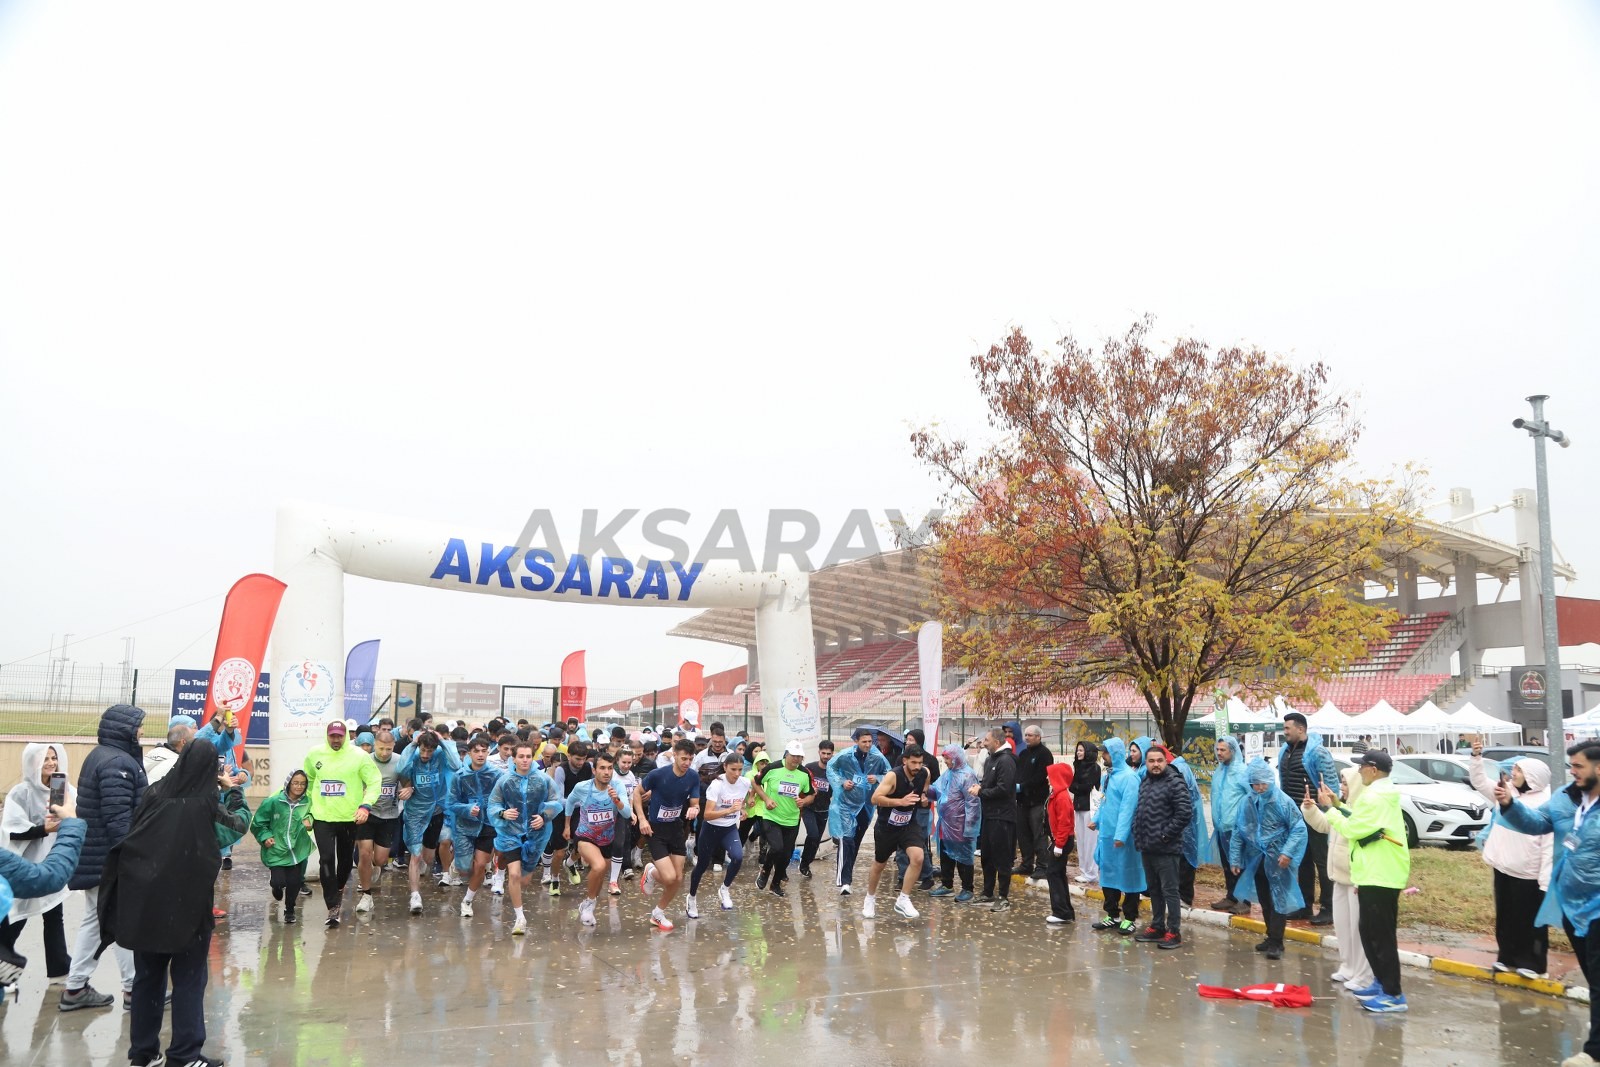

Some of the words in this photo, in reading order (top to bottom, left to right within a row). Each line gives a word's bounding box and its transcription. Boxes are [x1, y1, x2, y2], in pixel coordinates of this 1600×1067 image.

[430, 537, 704, 601] AKSARAY
[179, 678, 191, 686] Bu
[324, 783, 343, 793] 017
[380, 787, 393, 795] 03
[782, 785, 797, 794] 102
[592, 812, 611, 822] 014
